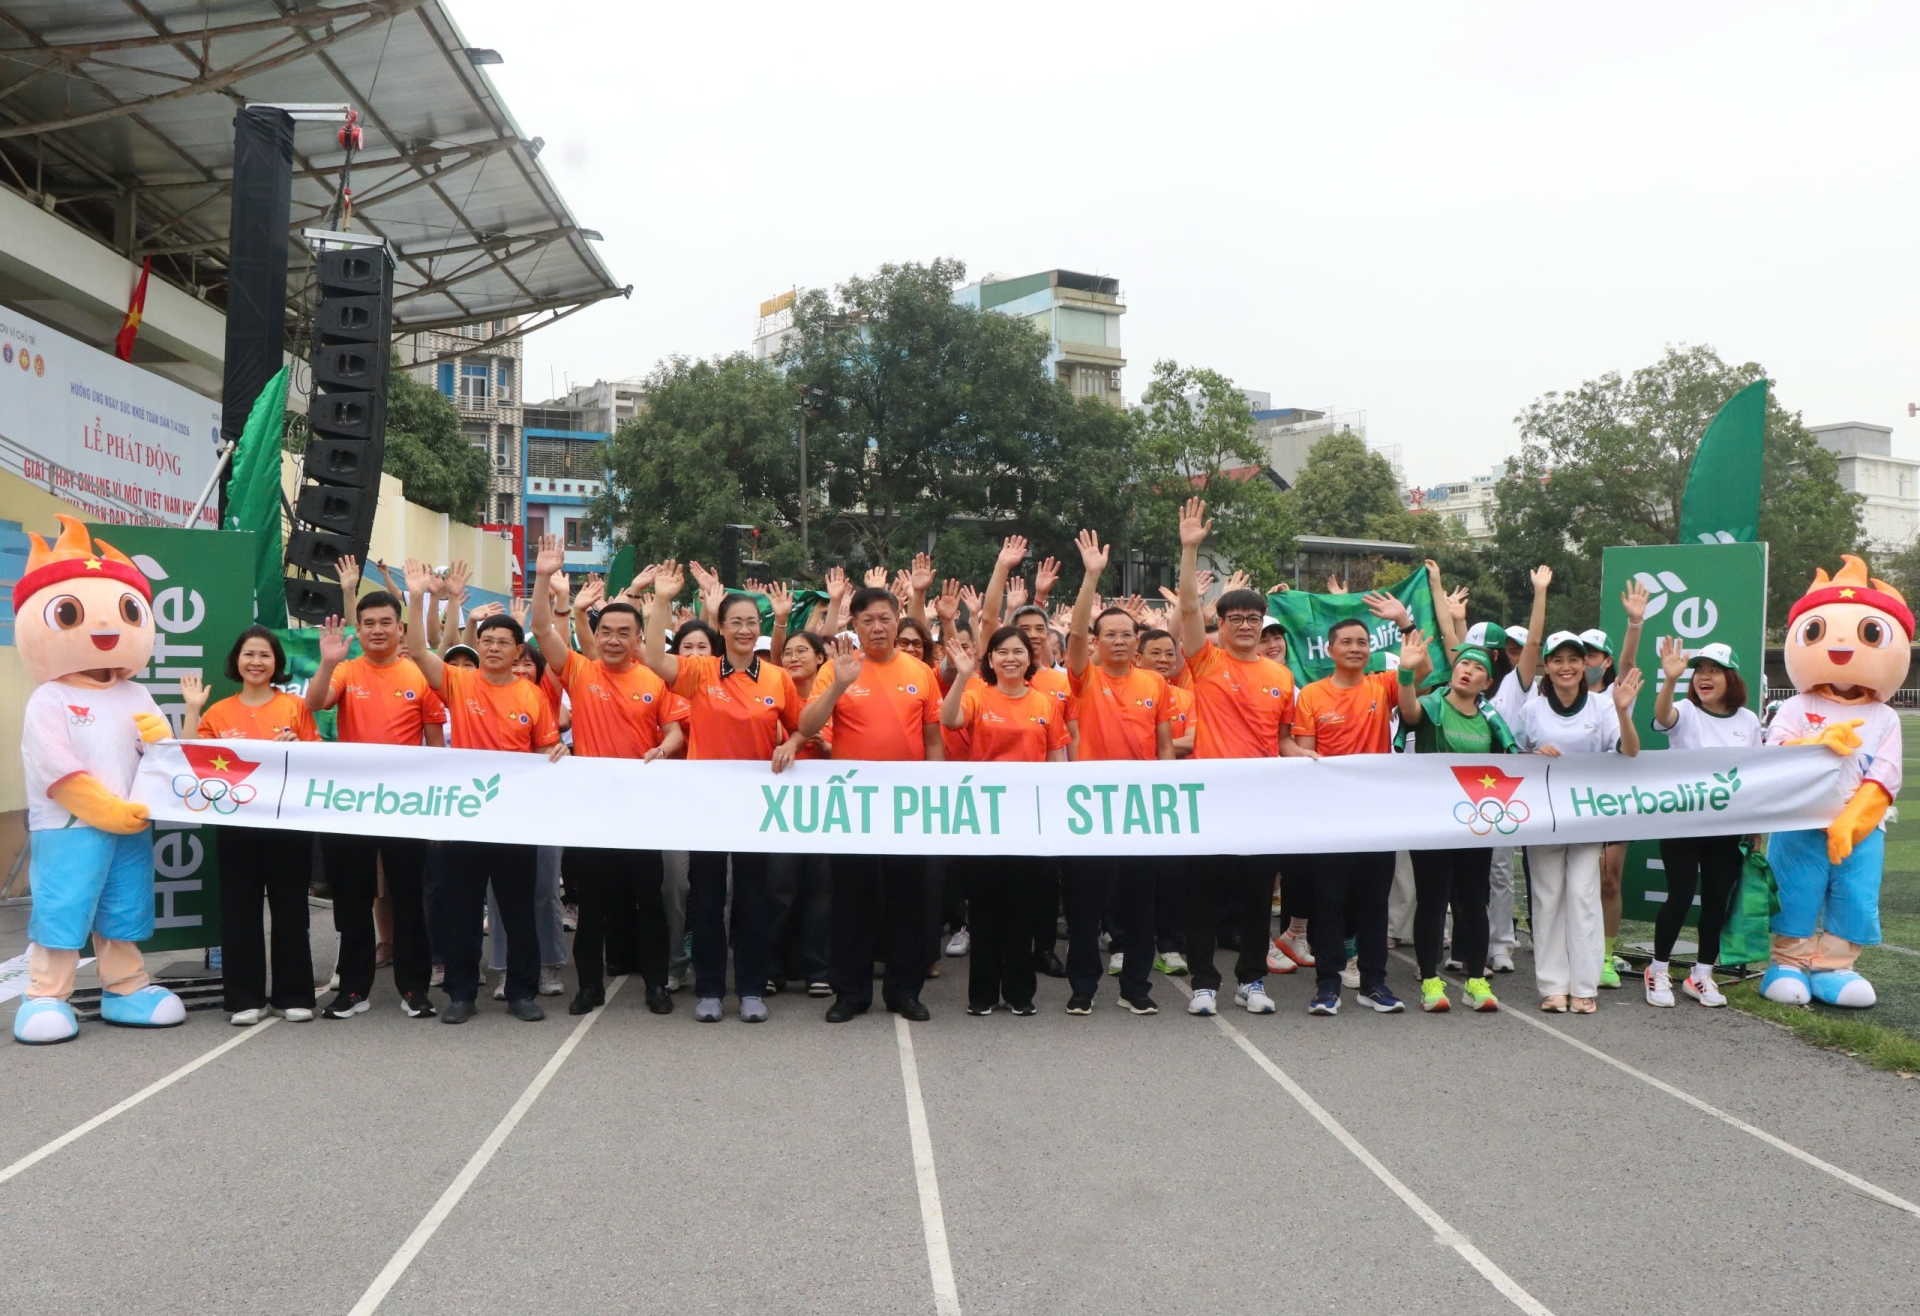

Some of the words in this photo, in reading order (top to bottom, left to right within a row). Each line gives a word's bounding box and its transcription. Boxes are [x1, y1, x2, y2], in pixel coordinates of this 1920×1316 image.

[84, 416, 103, 452] LỄ
[106, 433, 142, 464] PHÁT
[145, 443, 182, 476] ĐỘNG
[164, 495, 181, 515] NAM
[304, 778, 482, 818] Herbalife
[758, 769, 879, 834] XUẤT
[893, 775, 1007, 835] PHÁT
[1067, 783, 1205, 836] START
[1570, 782, 1731, 817] Herbalife
